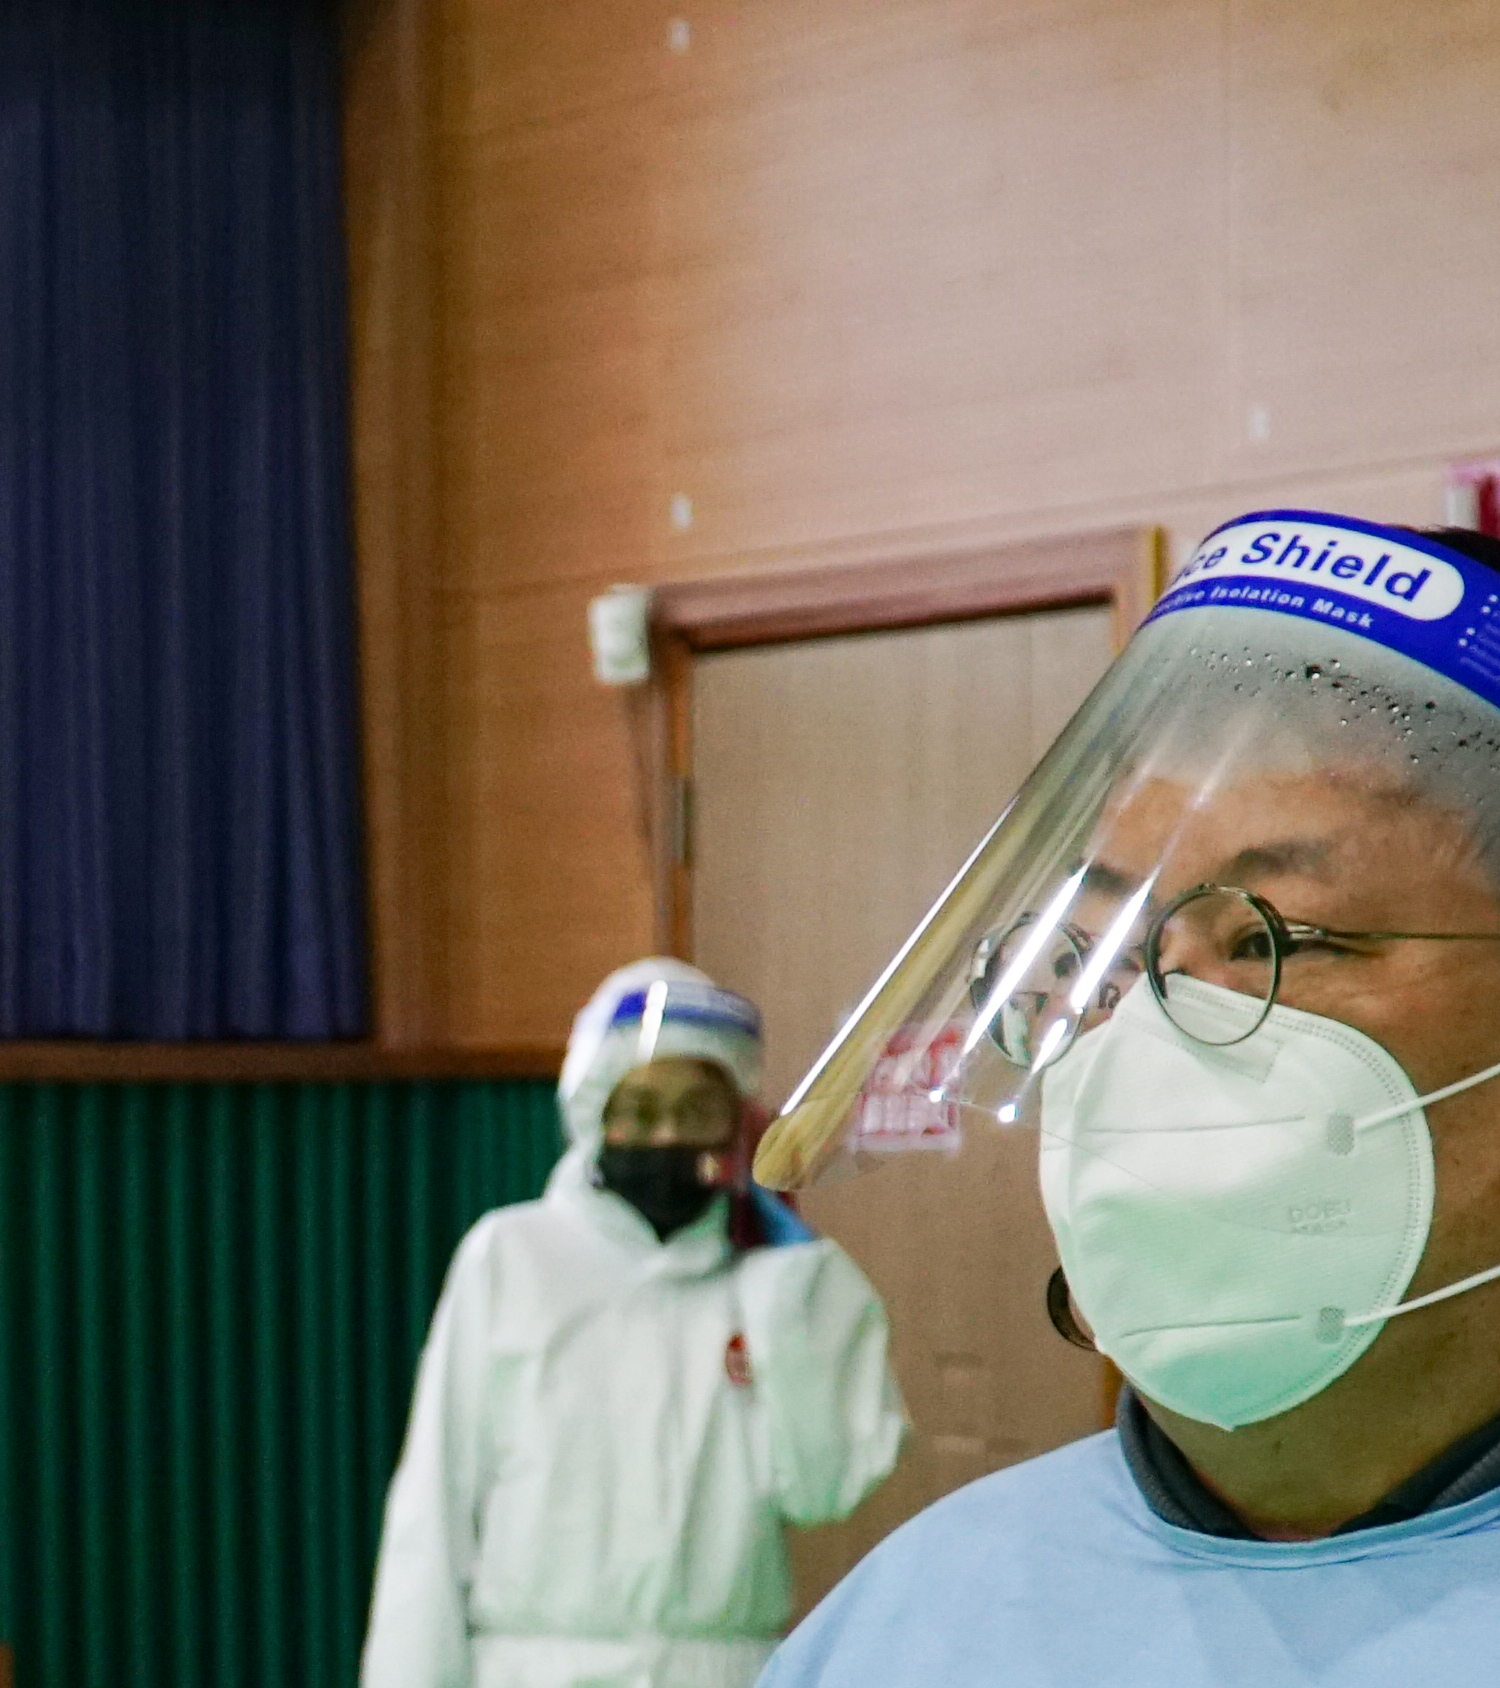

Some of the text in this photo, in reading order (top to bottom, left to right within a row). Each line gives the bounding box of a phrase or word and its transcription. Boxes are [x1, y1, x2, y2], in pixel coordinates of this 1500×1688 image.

[1241, 532, 1431, 602] Shield
[1210, 586, 1305, 608] Isolation
[1311, 598, 1375, 628] Mask
